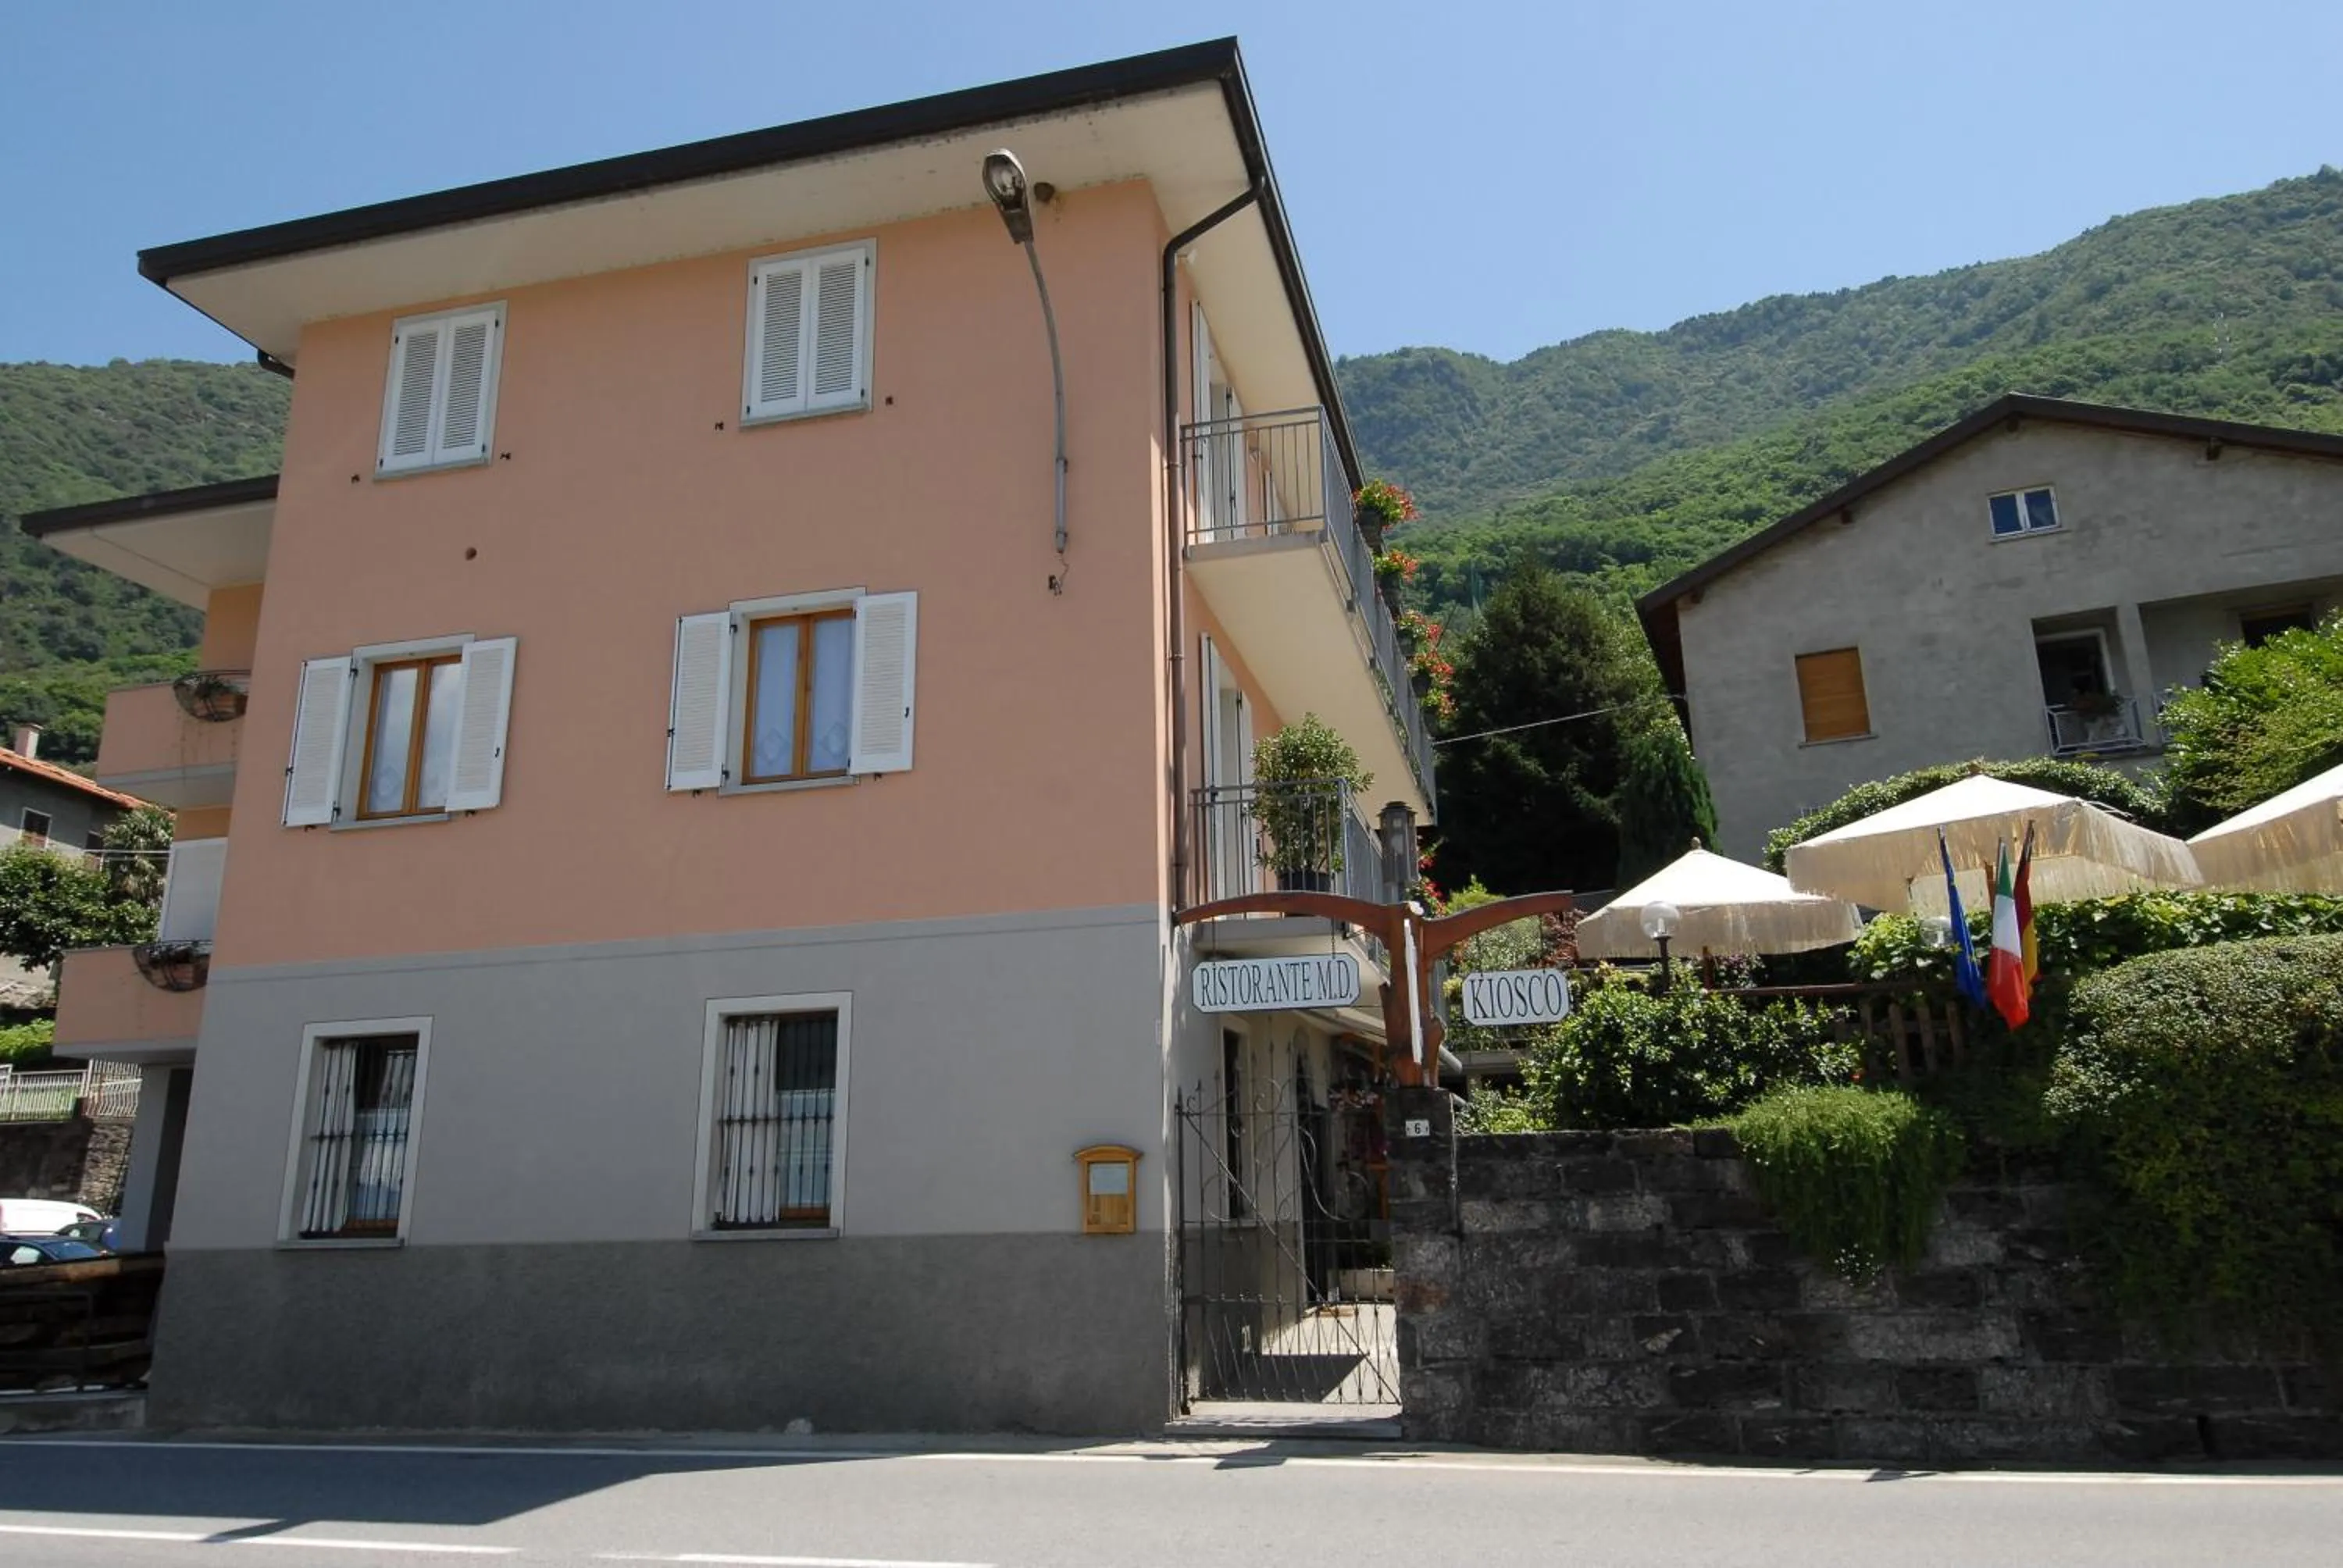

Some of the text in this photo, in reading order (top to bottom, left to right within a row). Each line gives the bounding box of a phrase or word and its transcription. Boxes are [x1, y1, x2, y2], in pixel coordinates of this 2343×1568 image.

[1200, 962, 1313, 1007] RISTORANTE
[1470, 974, 1562, 1019] KIOSCO
[1414, 1123, 1421, 1135] 6
